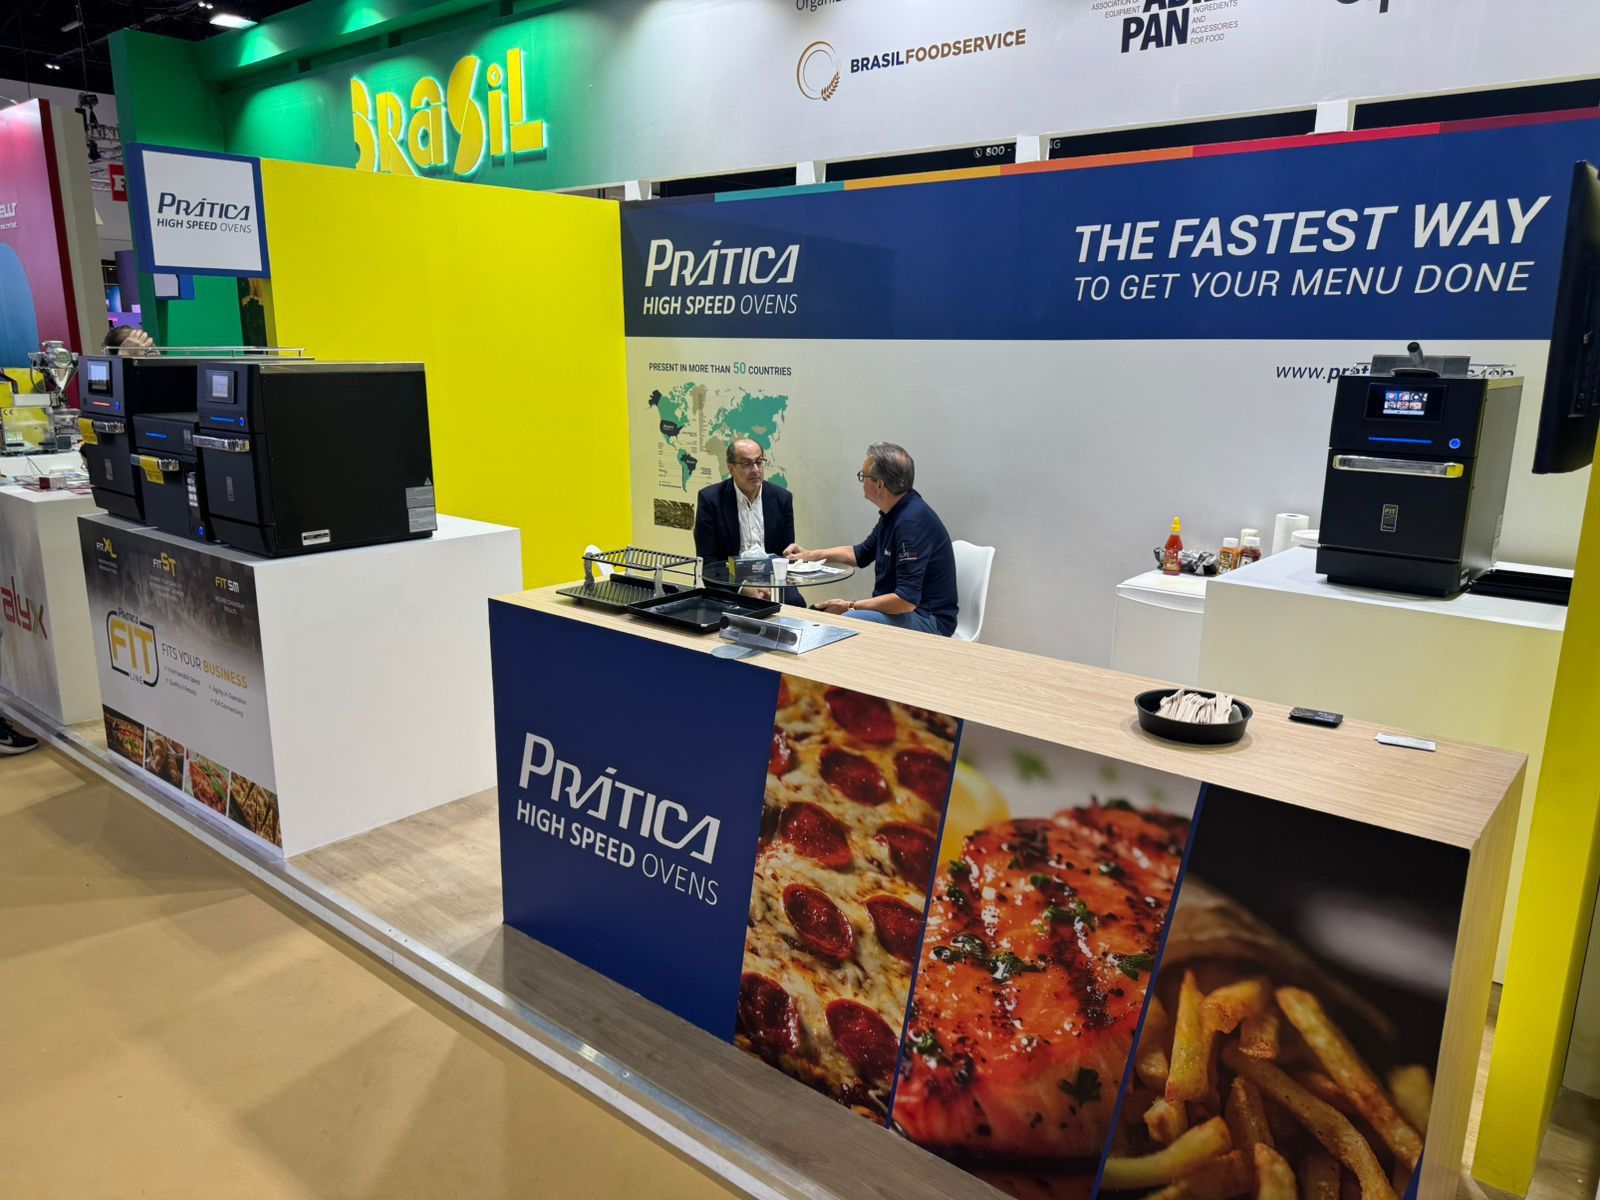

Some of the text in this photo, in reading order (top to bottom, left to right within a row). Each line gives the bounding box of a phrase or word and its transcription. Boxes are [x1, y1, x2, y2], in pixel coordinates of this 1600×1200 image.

[1105, 6, 1141, 18] EQUIPMENT
[1193, 0, 1238, 13] INGREDIENTS
[1191, 21, 1239, 34] ACCESSORIES
[1192, 16, 1206, 24] AND
[1121, 8, 1190, 53] PAN
[1190, 34, 1225, 45] FOR FOOD
[986, 146, 1005, 157] 800
[157, 218, 252, 234] HIGH SPEED OVENS
[1075, 195, 1552, 263] THE FASTEST WAY
[1074, 261, 1535, 302] TO GET YOUR MENU DONE
[643, 293, 798, 315] HIGH SPEED OVENS
[649, 362, 792, 376] PRESENT IN MORE THAN 50 COUNTRIES
[215, 576, 240, 593] FIT SM
[111, 618, 153, 675] FIT
[162, 643, 248, 689] FITS YOUR BUSINESS
[516, 799, 719, 906] HIGH SPEED OVENS
